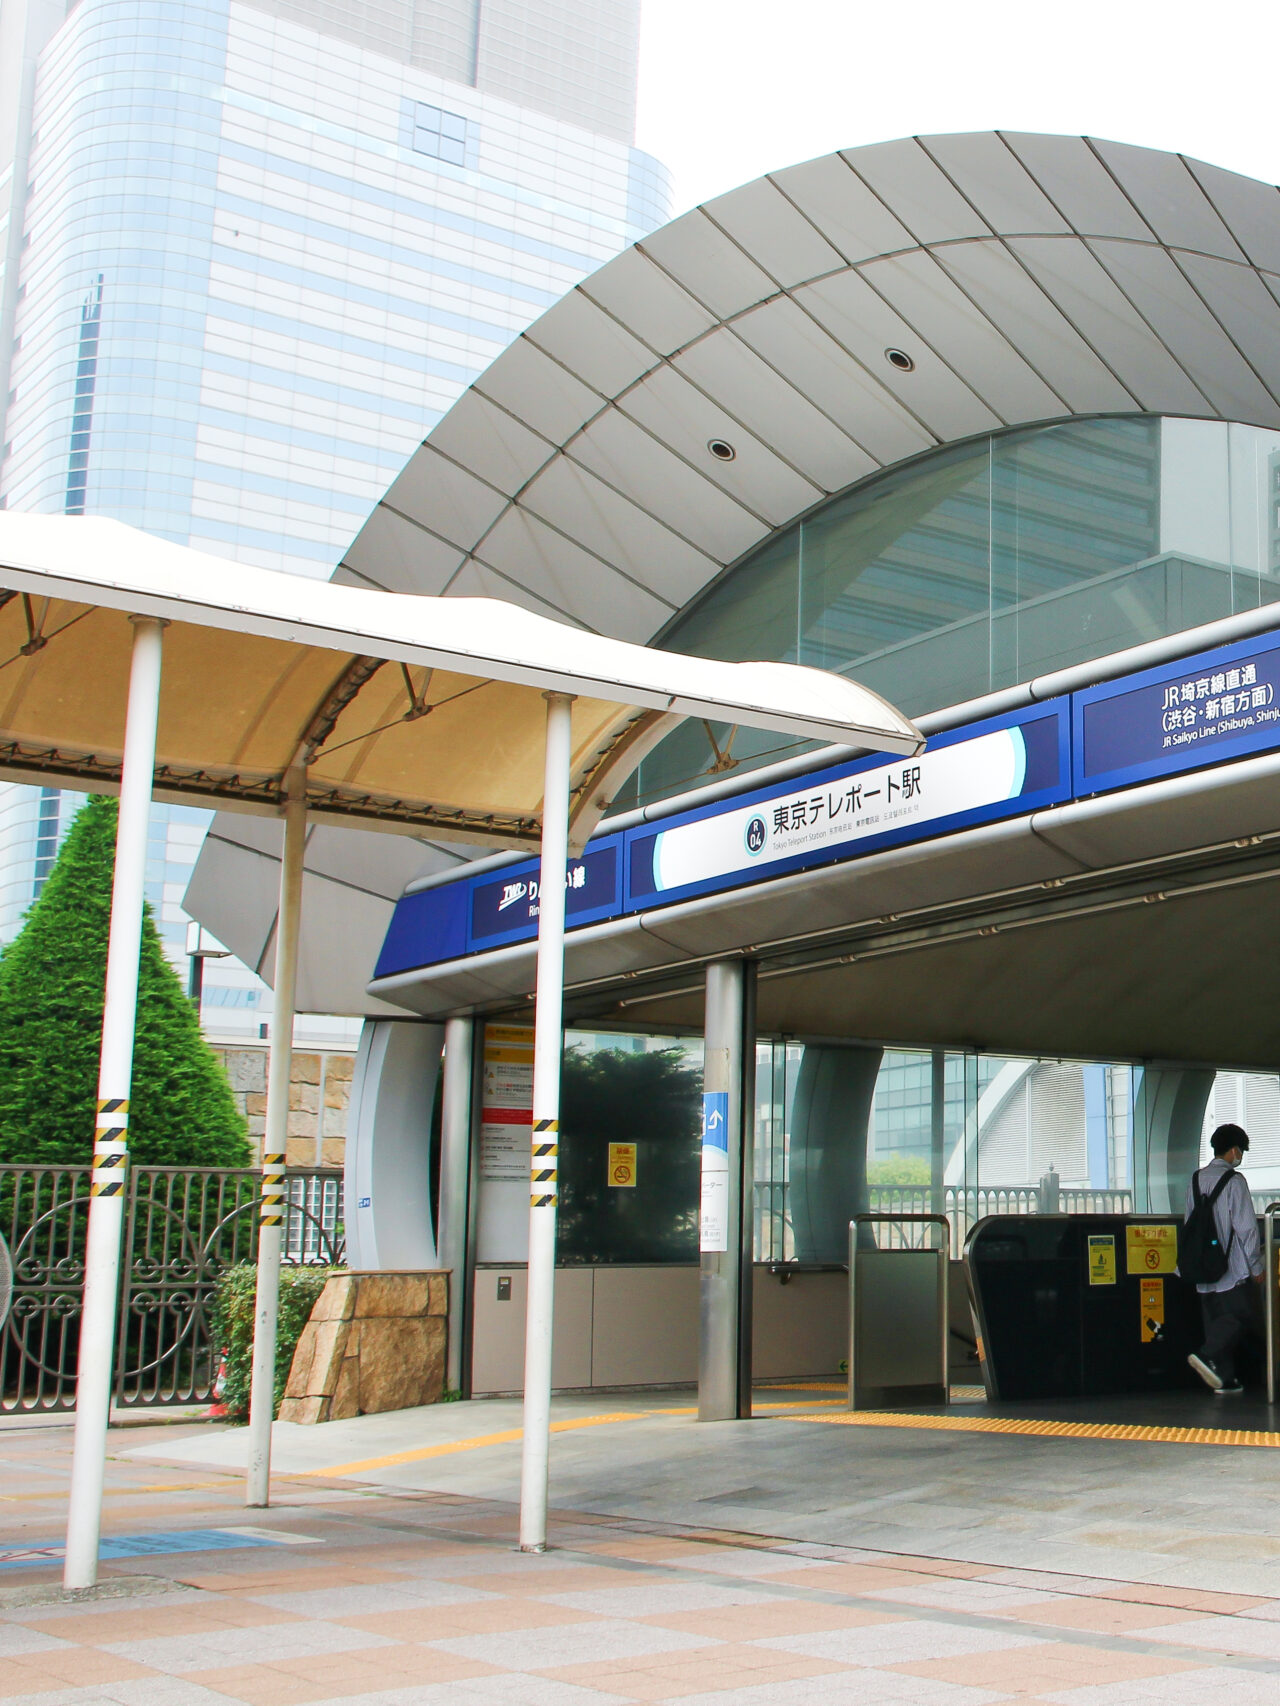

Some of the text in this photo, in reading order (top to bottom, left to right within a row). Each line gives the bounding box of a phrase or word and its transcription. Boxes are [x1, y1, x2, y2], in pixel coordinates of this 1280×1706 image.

[1161, 664, 1256, 710] JR埼京線直通
[1162, 736, 1171, 748] JR
[1172, 730, 1198, 747] Saikyo
[1199, 725, 1216, 739] Line
[1217, 716, 1254, 735] (Shibuya,
[773, 766, 921, 835] 東京テレポート駅
[753, 820, 759, 831] R
[749, 832, 761, 849] 04
[773, 839, 788, 850] Tokyo
[788, 834, 808, 848] Teleport
[808, 830, 827, 841] Station
[529, 905, 540, 917] Rin
